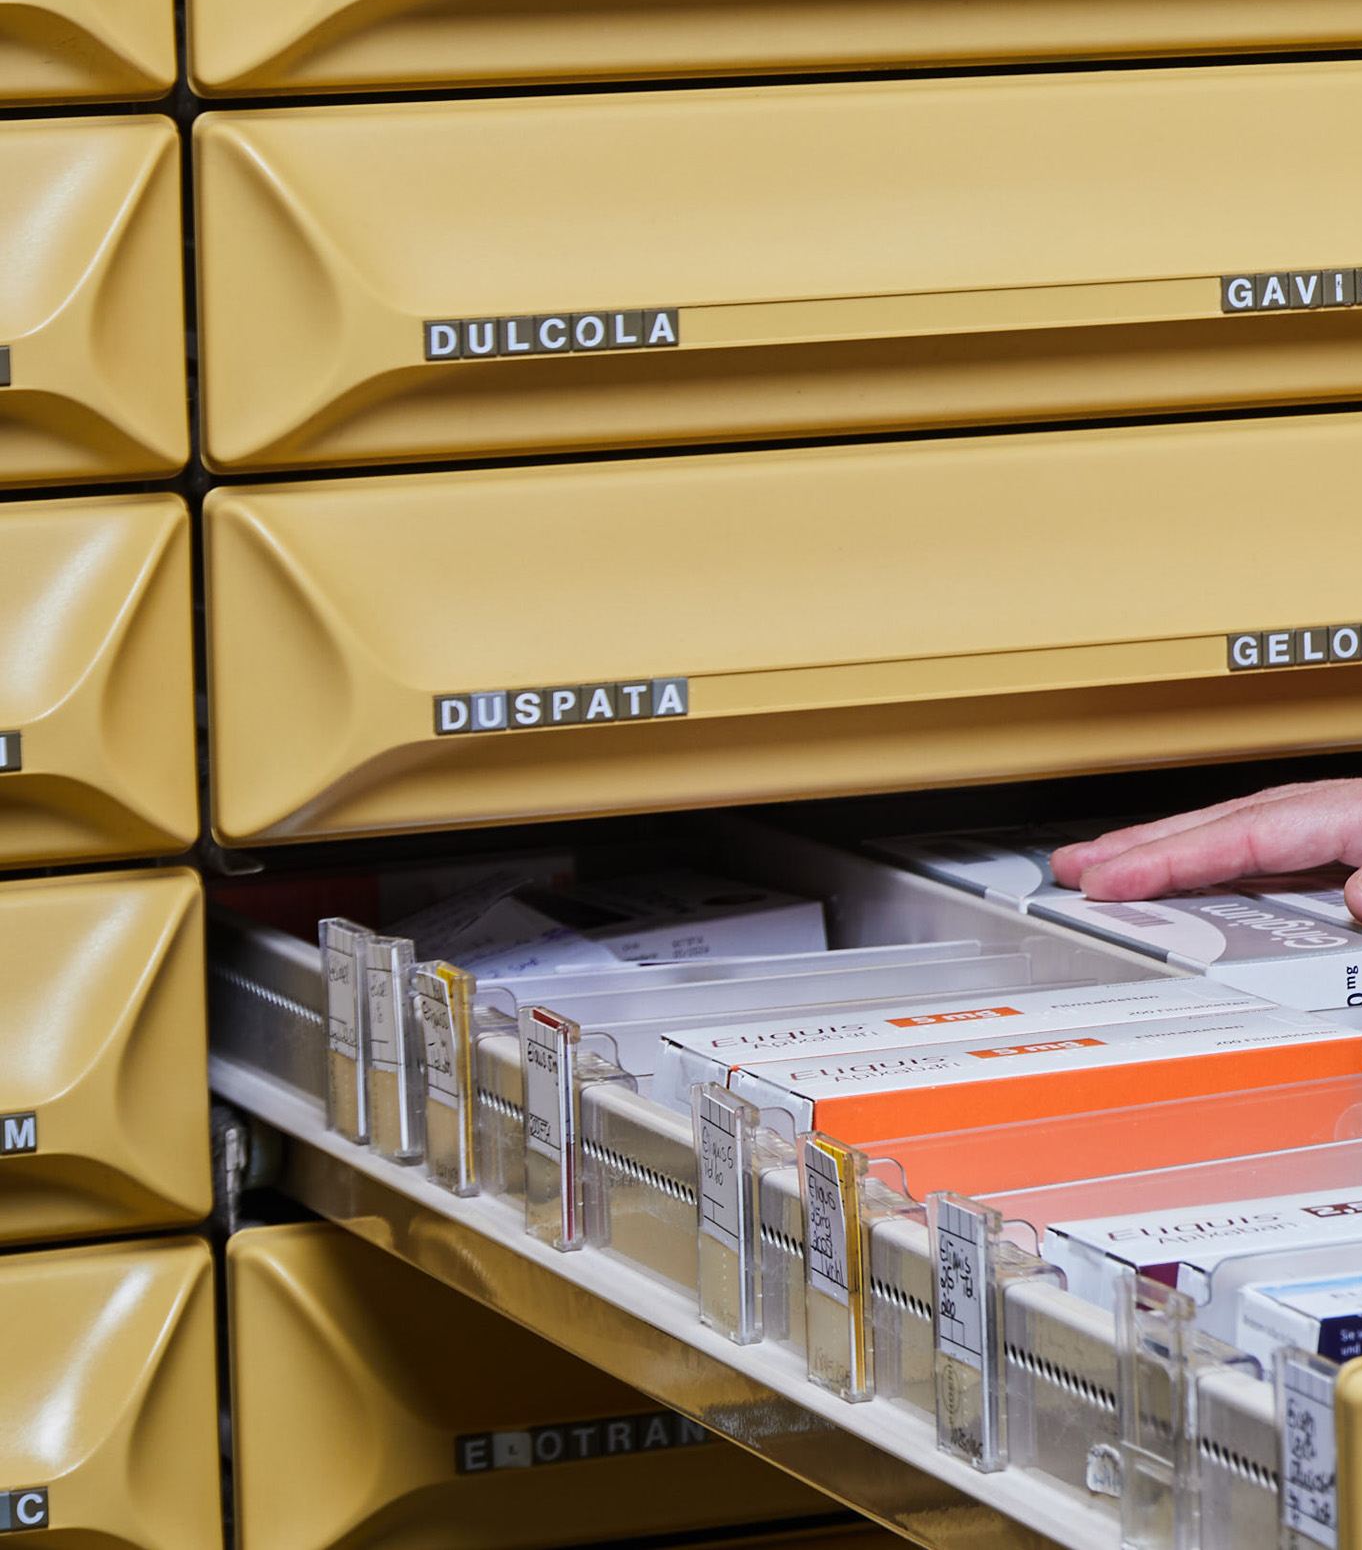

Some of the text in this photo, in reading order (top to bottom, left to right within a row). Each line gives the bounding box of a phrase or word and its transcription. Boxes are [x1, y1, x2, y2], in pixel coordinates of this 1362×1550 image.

[430, 313, 675, 355] DULCOLA
[441, 683, 684, 730] DUSPATA
[1200, 903, 1349, 949] Gingium
[711, 1023, 866, 1049] Eliquis
[790, 1055, 947, 1082] Eliquis
[1107, 1212, 1280, 1242] Eliquis
